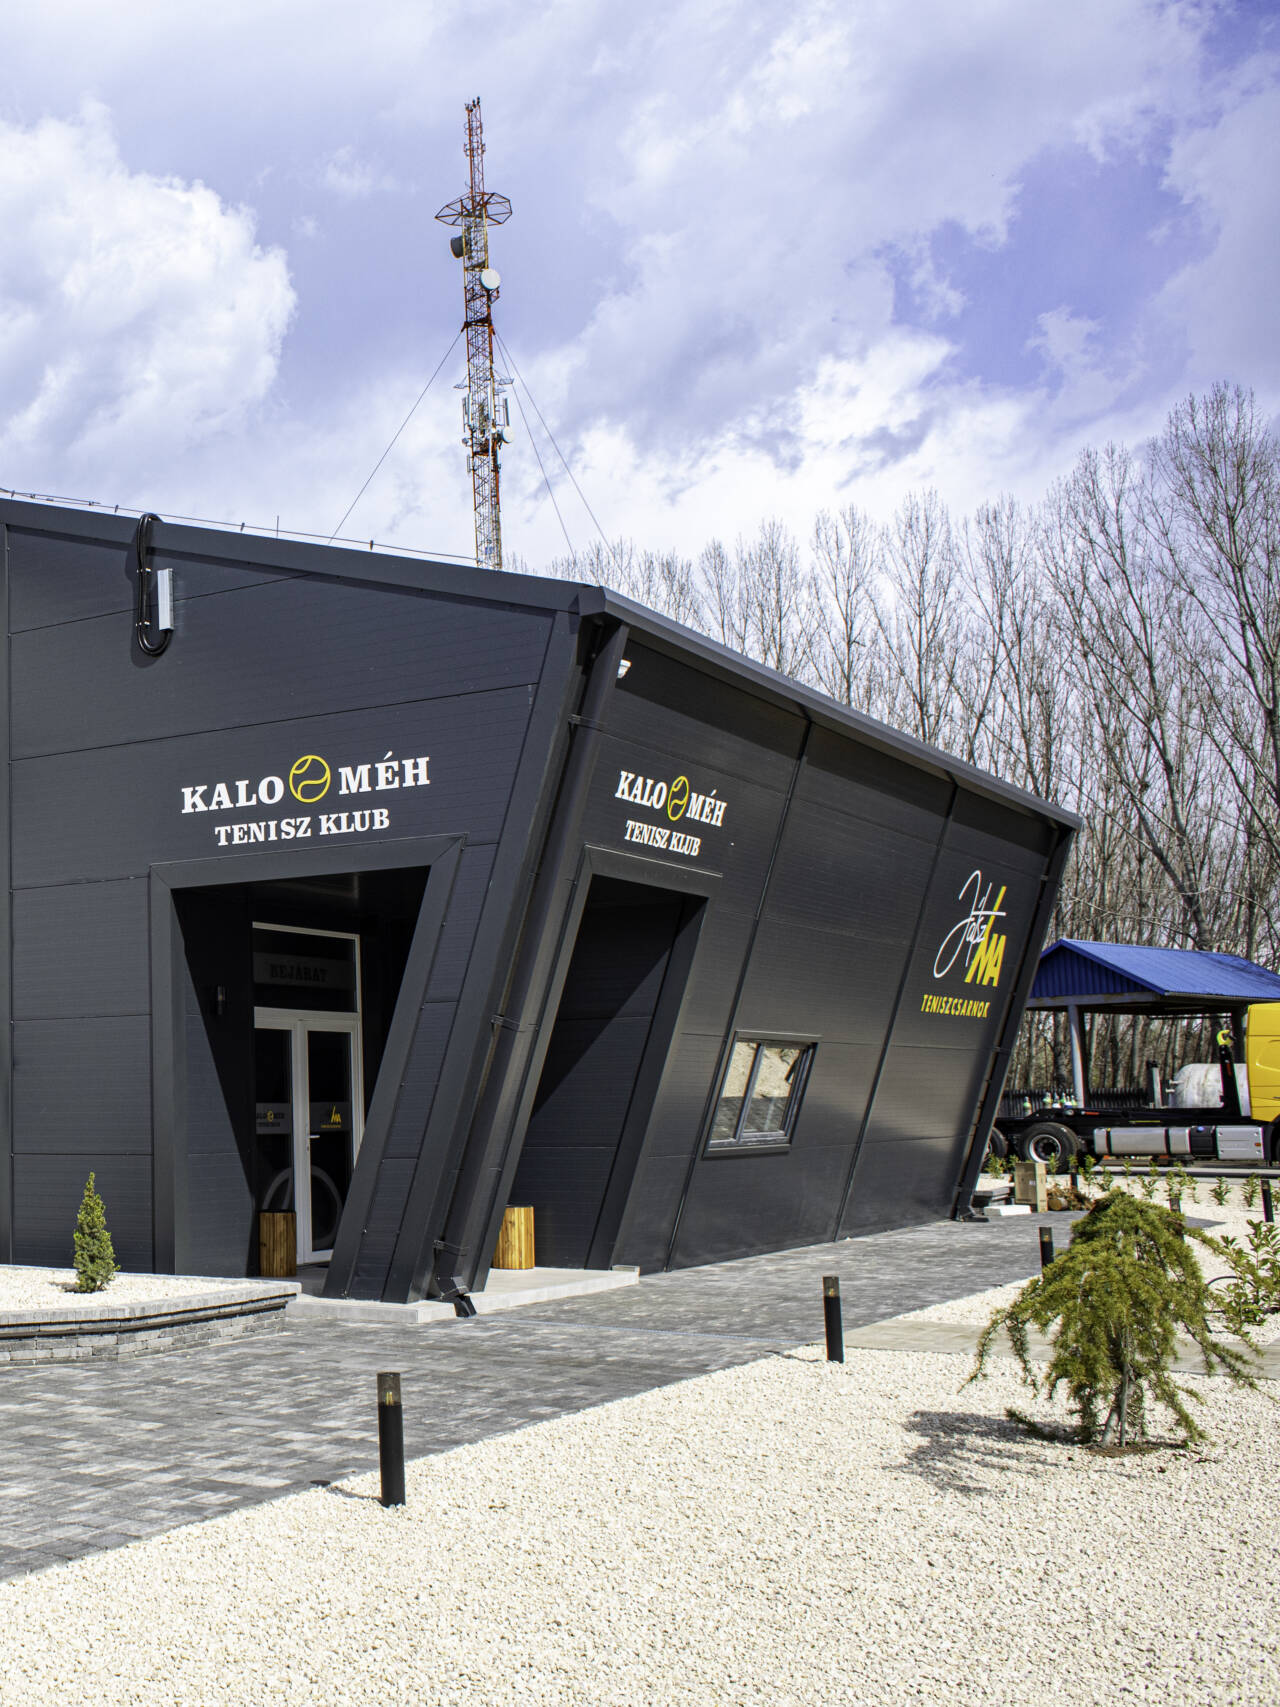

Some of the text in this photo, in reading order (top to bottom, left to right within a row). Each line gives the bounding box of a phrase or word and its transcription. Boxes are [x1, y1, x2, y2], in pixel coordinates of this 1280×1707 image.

[181, 750, 431, 814] KALO MÉH
[615, 771, 727, 827] KALO MÉH
[215, 807, 391, 846] TENISZ KLUB
[624, 819, 702, 857] TENISZ KLUB
[270, 963, 328, 982] BEJÁRAT
[920, 994, 991, 1018] TENISZCSARNOK
